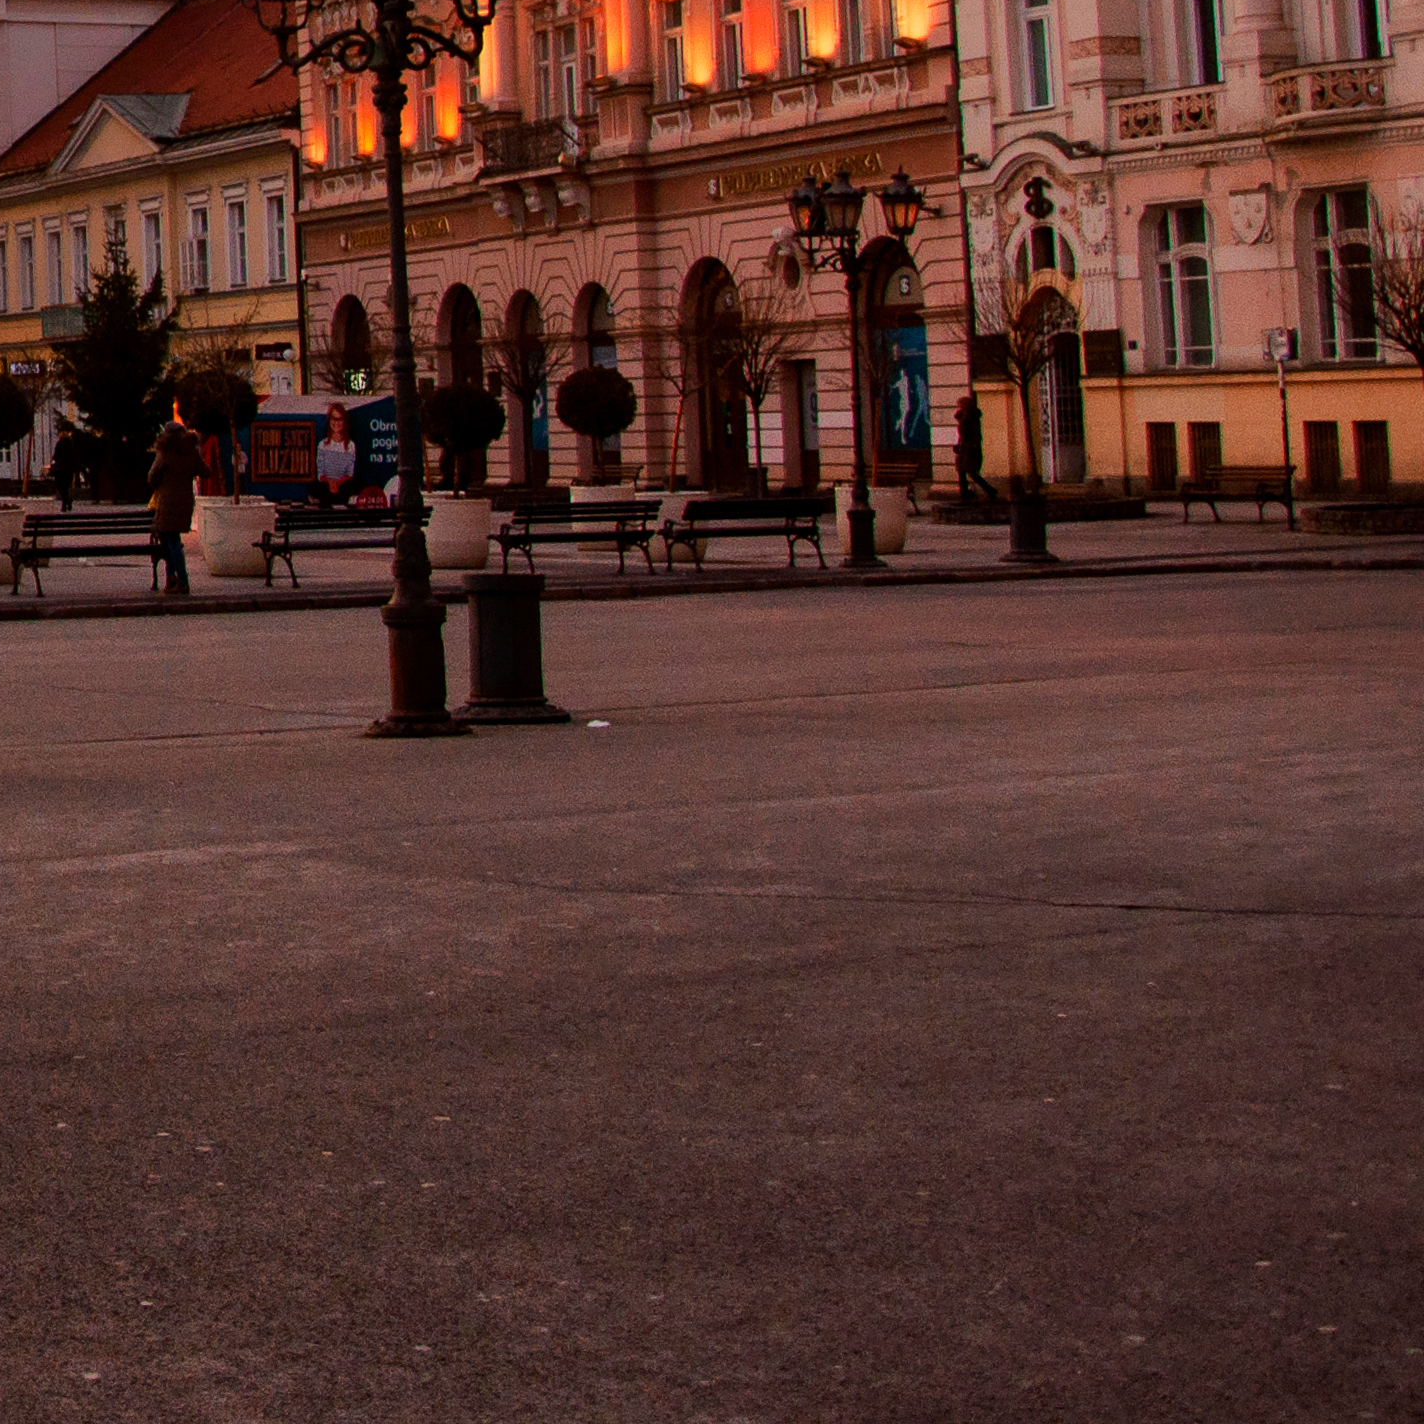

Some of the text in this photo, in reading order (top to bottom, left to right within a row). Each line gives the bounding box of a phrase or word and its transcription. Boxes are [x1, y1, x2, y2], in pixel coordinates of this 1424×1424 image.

[370, 419, 397, 431] Obrn
[370, 454, 398, 463] na sv
